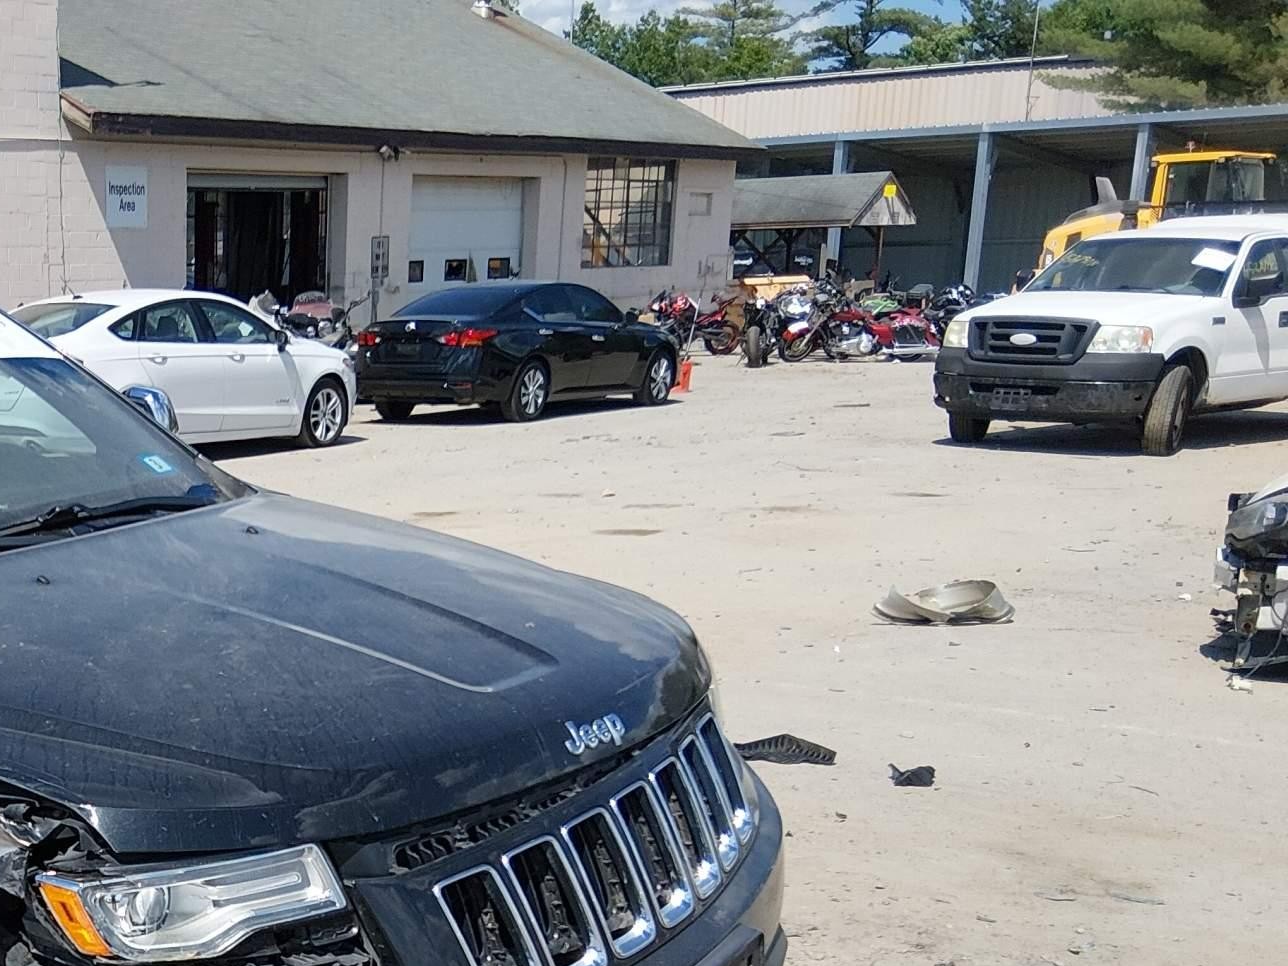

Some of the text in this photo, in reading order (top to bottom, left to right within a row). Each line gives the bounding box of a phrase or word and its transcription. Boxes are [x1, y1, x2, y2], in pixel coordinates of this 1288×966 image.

[108, 180, 145, 198] Inspection
[119, 198, 136, 213] Area
[564, 713, 626, 755] Jeep
